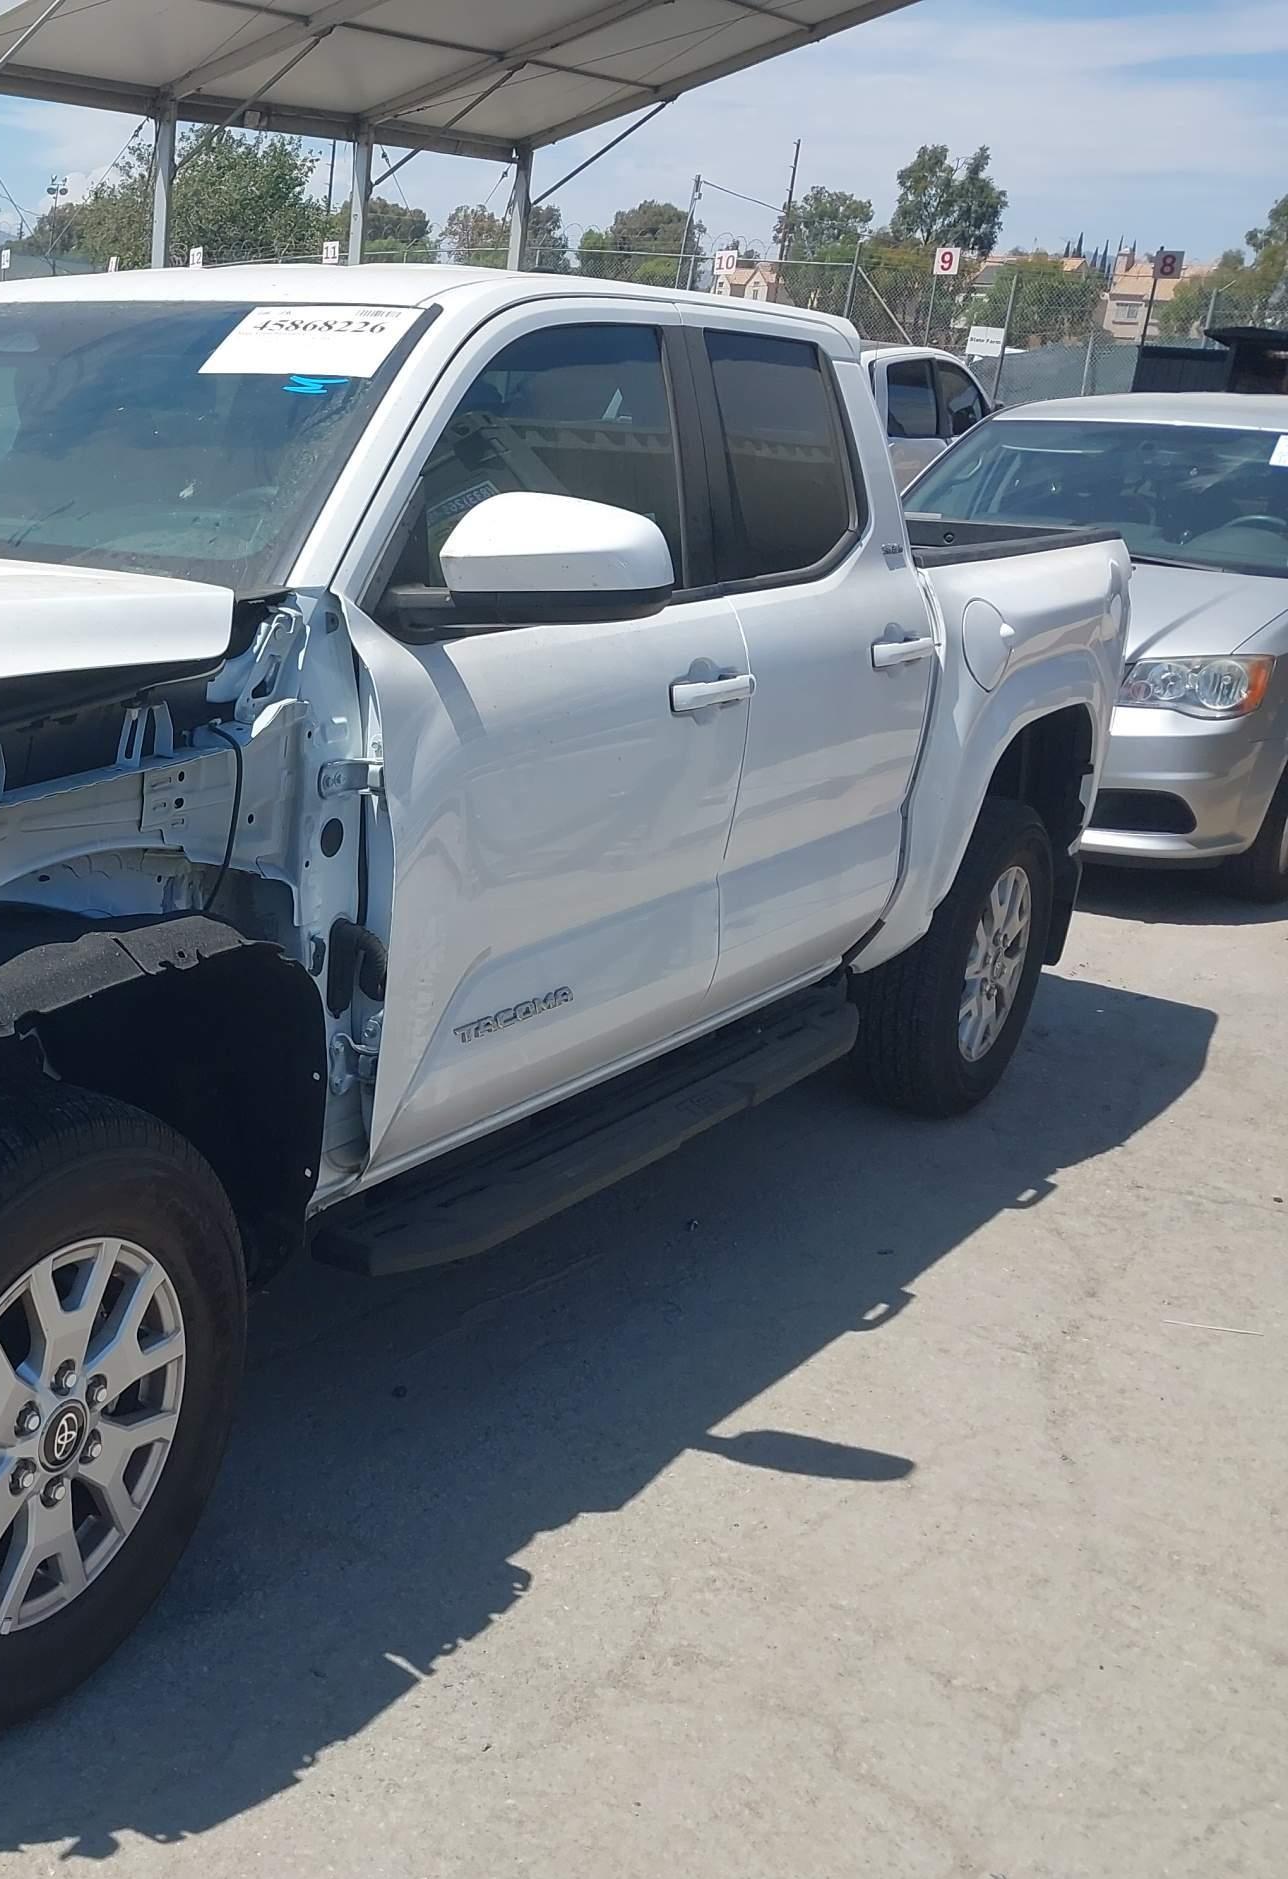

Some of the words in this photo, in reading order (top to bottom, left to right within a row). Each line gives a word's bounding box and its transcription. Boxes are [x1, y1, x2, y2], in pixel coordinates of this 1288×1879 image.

[190, 252, 202, 265] 12
[324, 246, 337, 260] 11
[940, 251, 954, 271] 9
[715, 255, 735, 270] 10
[1159, 254, 1177, 276] 8
[253, 319, 386, 335] 45868226
[453, 986, 574, 1044] TACOMA
